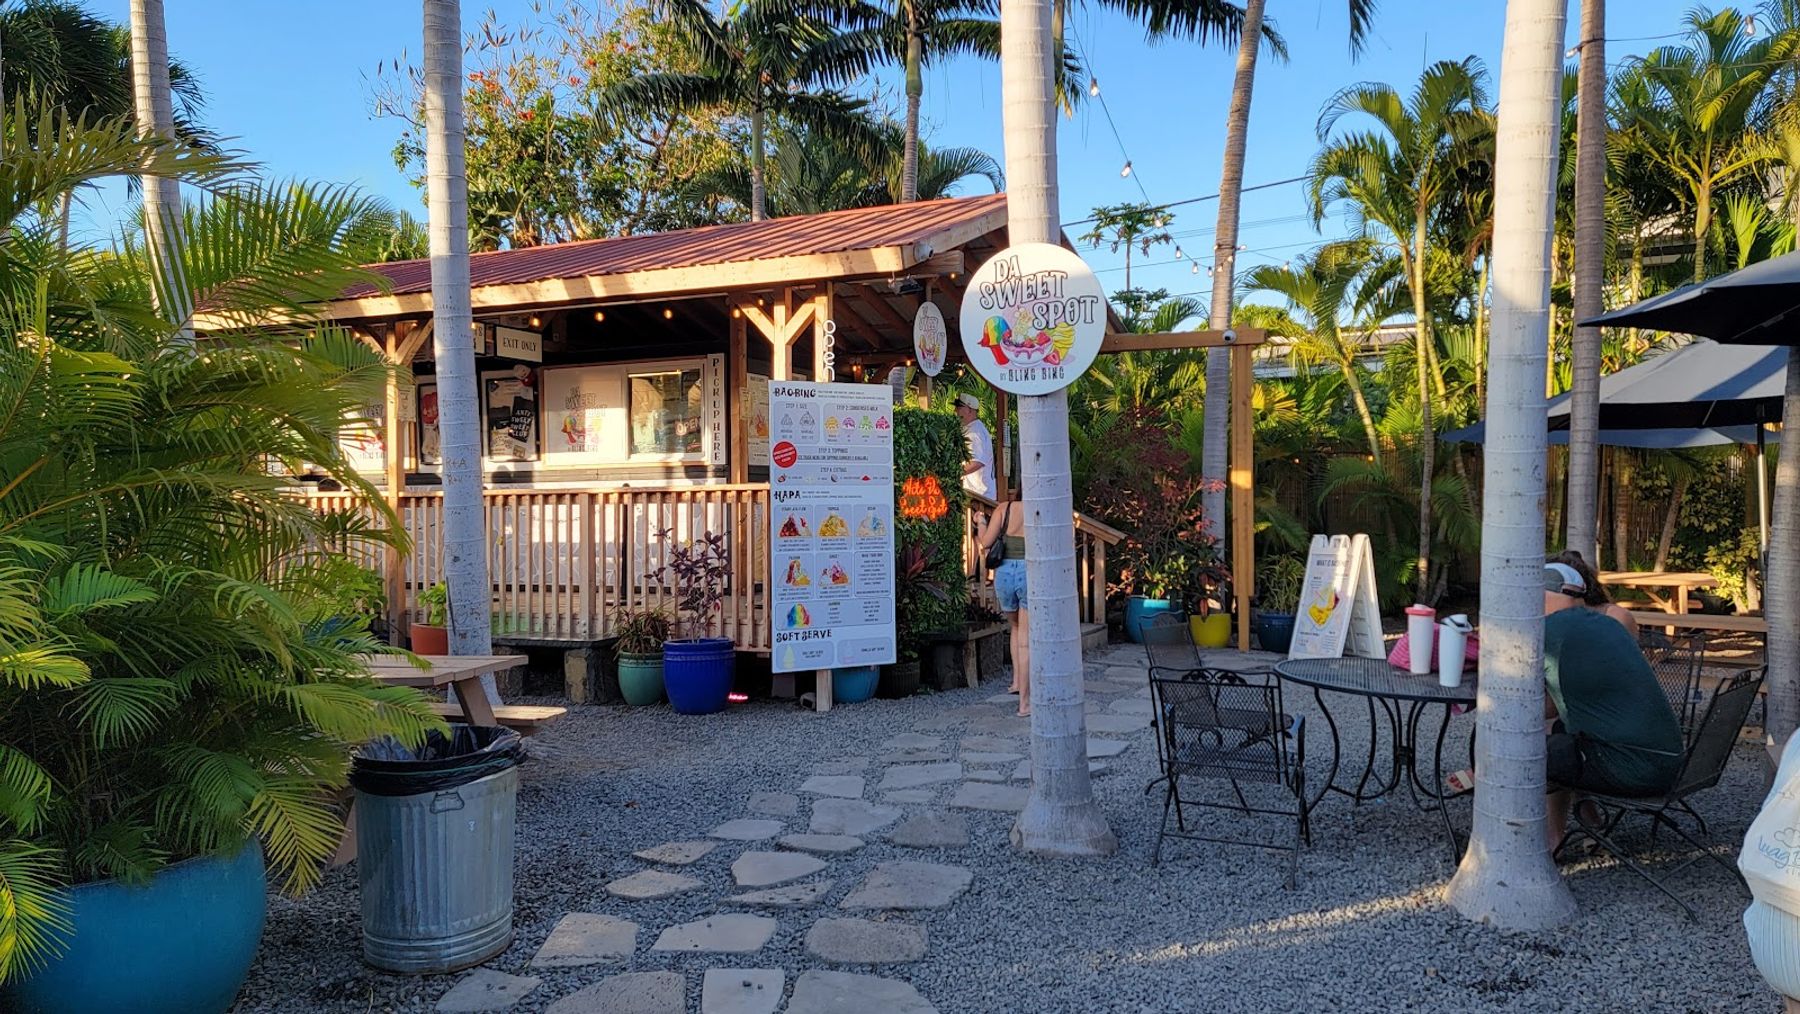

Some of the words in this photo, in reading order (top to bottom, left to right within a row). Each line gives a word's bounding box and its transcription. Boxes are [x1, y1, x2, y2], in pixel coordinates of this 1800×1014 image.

[994, 255, 1021, 283] DA
[980, 270, 1068, 310] SWEET
[1032, 296, 1098, 330] SPOT
[503, 337, 518, 349] EXIT
[521, 340, 536, 352] ONLY
[712, 358, 720, 397] PICK
[1008, 368, 1036, 382] BLING
[1041, 366, 1065, 380] BING
[713, 400, 720, 419] UP
[713, 423, 721, 461] HERE
[774, 490, 801, 503] HAPA
[776, 632, 800, 643] SOFT
[801, 629, 832, 642] SERVE
